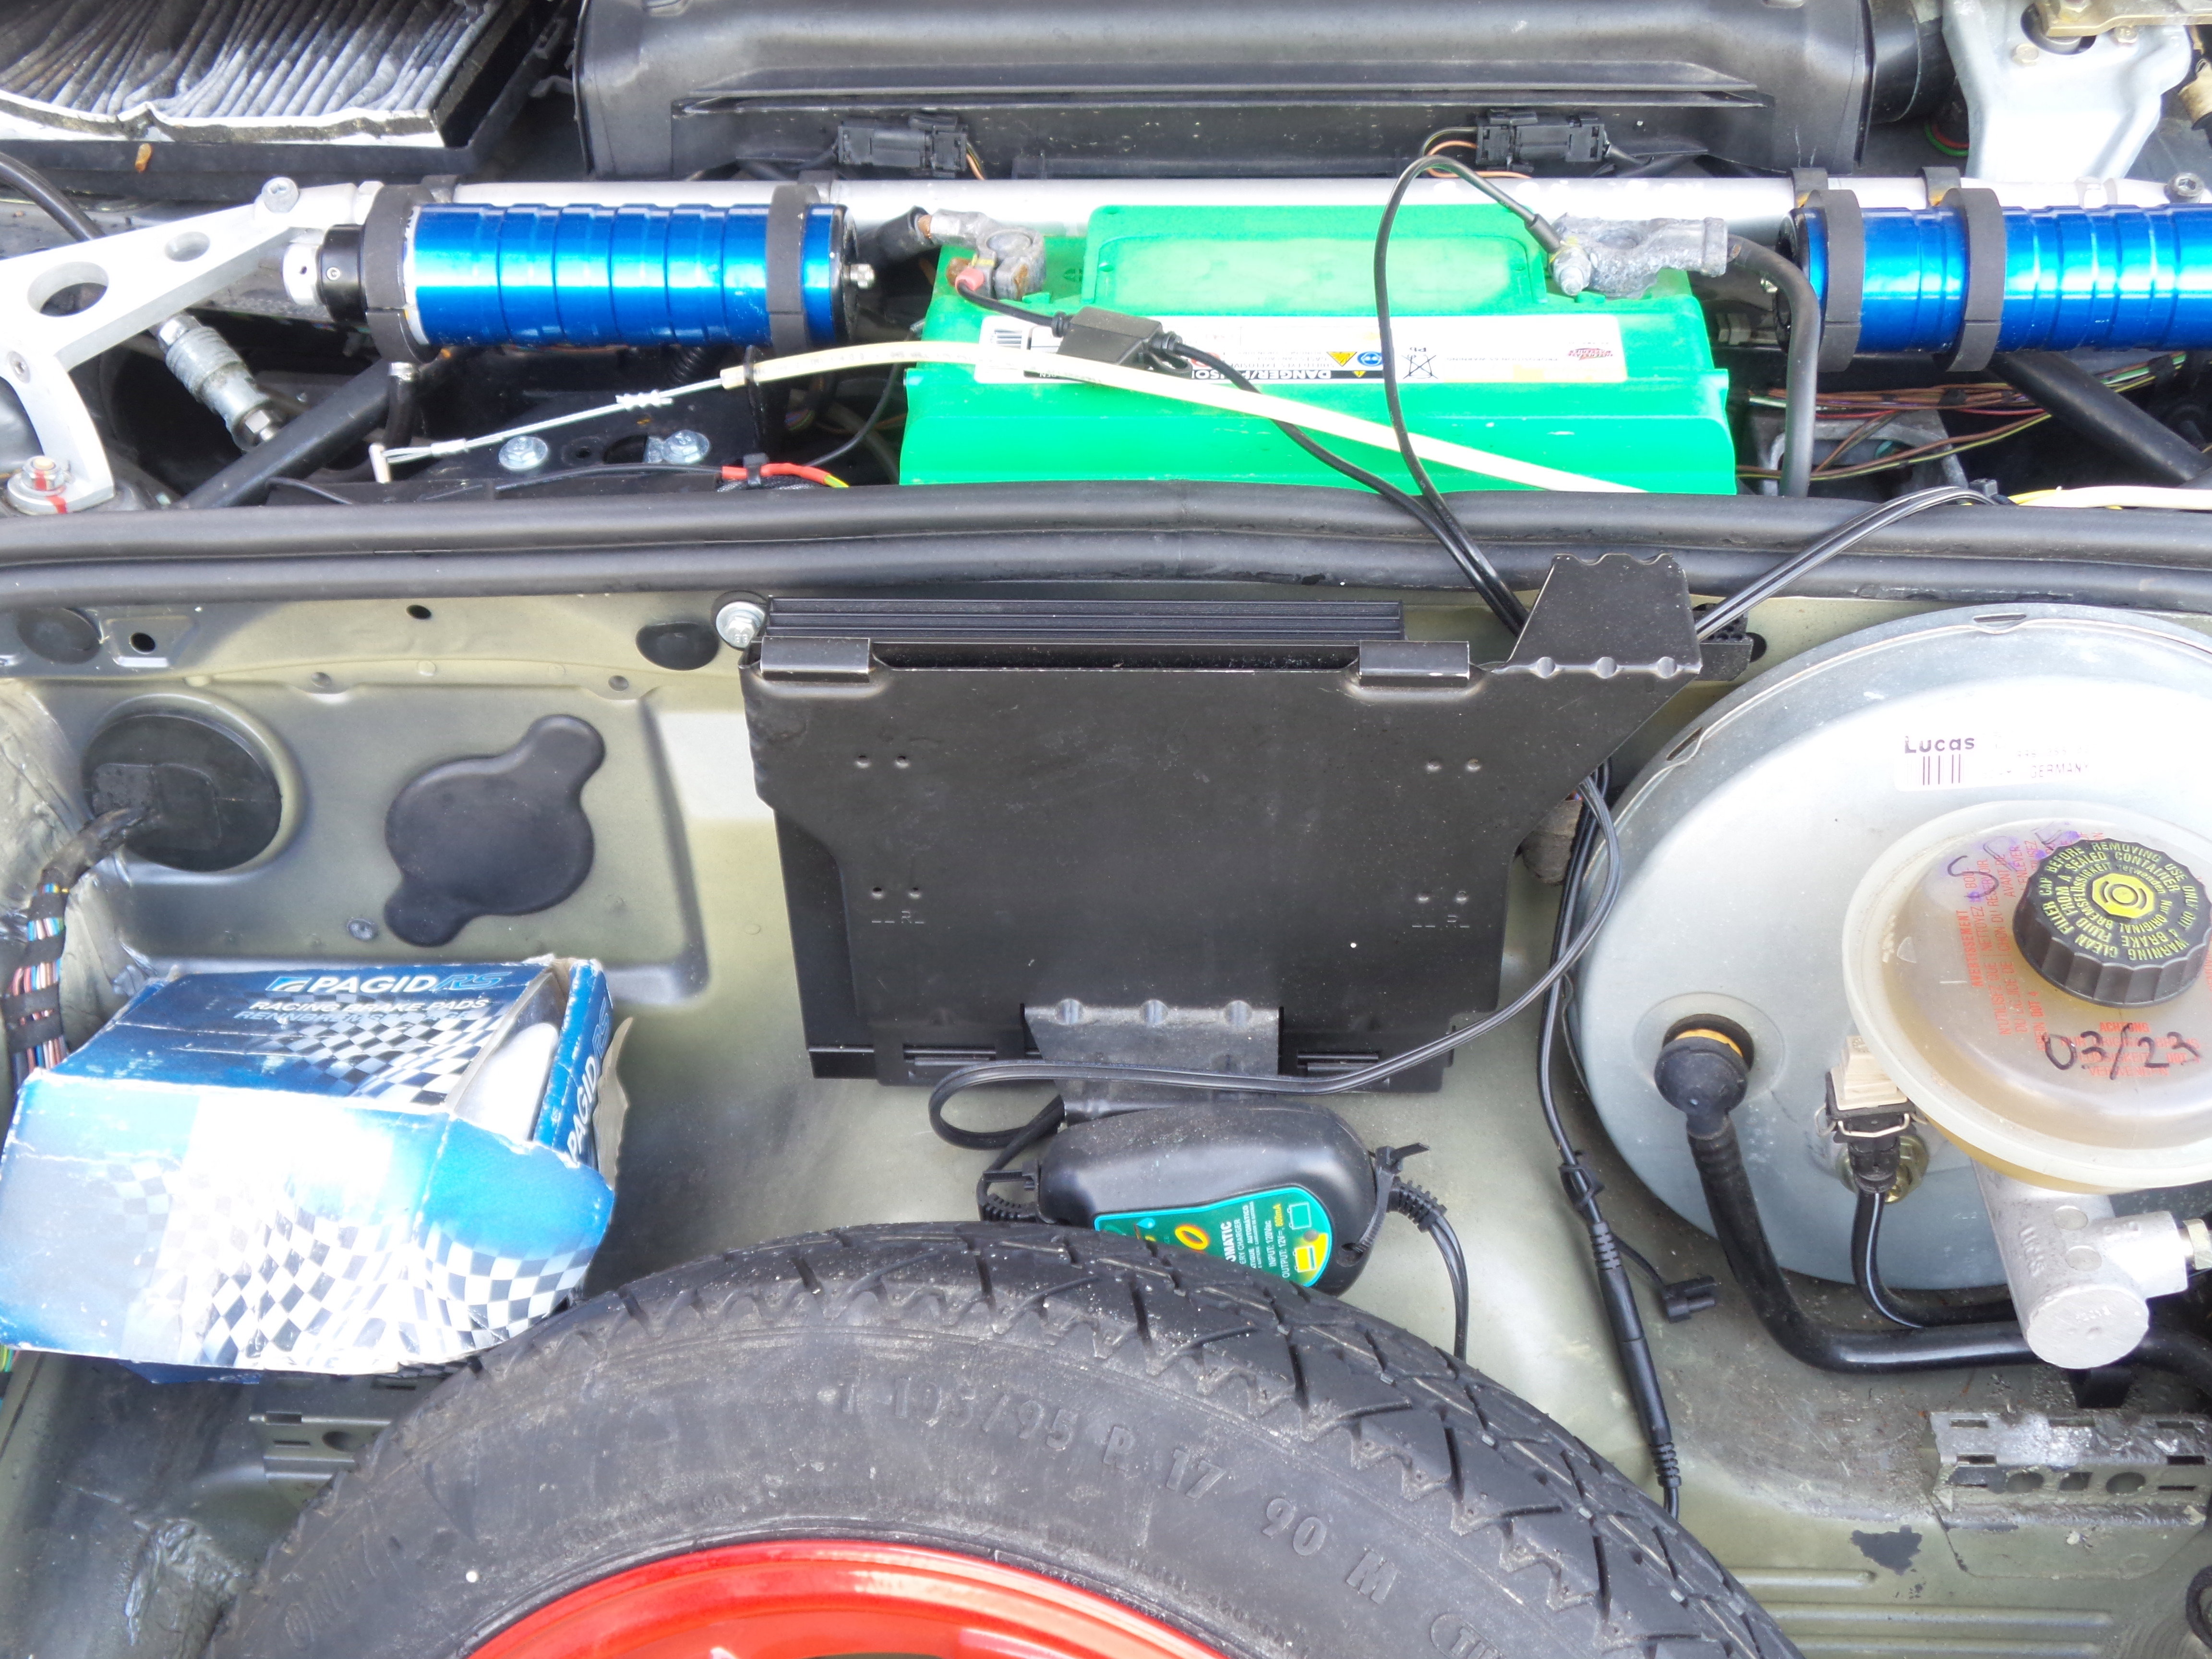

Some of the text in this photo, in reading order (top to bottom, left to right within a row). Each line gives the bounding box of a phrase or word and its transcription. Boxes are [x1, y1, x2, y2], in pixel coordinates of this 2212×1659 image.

[1904, 735, 1974, 754] Lucas
[2031, 762, 2089, 779] GERMANY
[2044, 846, 2085, 873] BEFORE
[2064, 851, 2108, 872] SEALED
[2091, 842, 2161, 863] REMOVING
[1997, 869, 2016, 898] AVANT
[2115, 851, 2181, 892] CONTAINER
[2163, 863, 2188, 882] USE
[2039, 877, 2053, 896] CAP
[2182, 885, 2199, 910] ONLY
[2055, 886, 2079, 916] FROM
[2159, 900, 2173, 915] Nur
[1971, 906, 1993, 951] NETTOYEZ
[2043, 901, 2075, 935] FILLER
[2075, 917, 2112, 943] FLUID
[2119, 914, 2169, 934] ORIGINAL
[2177, 911, 2197, 930] DOT
[1956, 911, 1984, 987] AVERTISSEMENT
[1994, 926, 2011, 951] CHON
[2075, 934, 2118, 958] CLEAN
[2121, 931, 2169, 948] BRAKE
[2128, 938, 2190, 960] WARNING
[1984, 962, 2000, 981] QUE
[2001, 962, 2015, 974] DE
[308, 971, 512, 994] PAGID RS
[249, 998, 491, 1012] RACING BRAKE PADS
[2014, 1018, 2029, 1032] DU
[2041, 1022, 2201, 1081] 03/23
[567, 997, 610, 1164] PAGID RS
[1234, 1218, 1245, 1250] CHARGER
[1242, 1204, 1253, 1244] AUTOMÁTICO
[1263, 1220, 1277, 1267] INPUT: 120Vac
[1279, 1249, 1290, 1278] OUTPUT:
[1103, 1424, 1140, 1480] R
[1166, 1447, 1227, 1501] 17
[1262, 1496, 1327, 1557] 90
[1345, 1547, 1399, 1605] M
